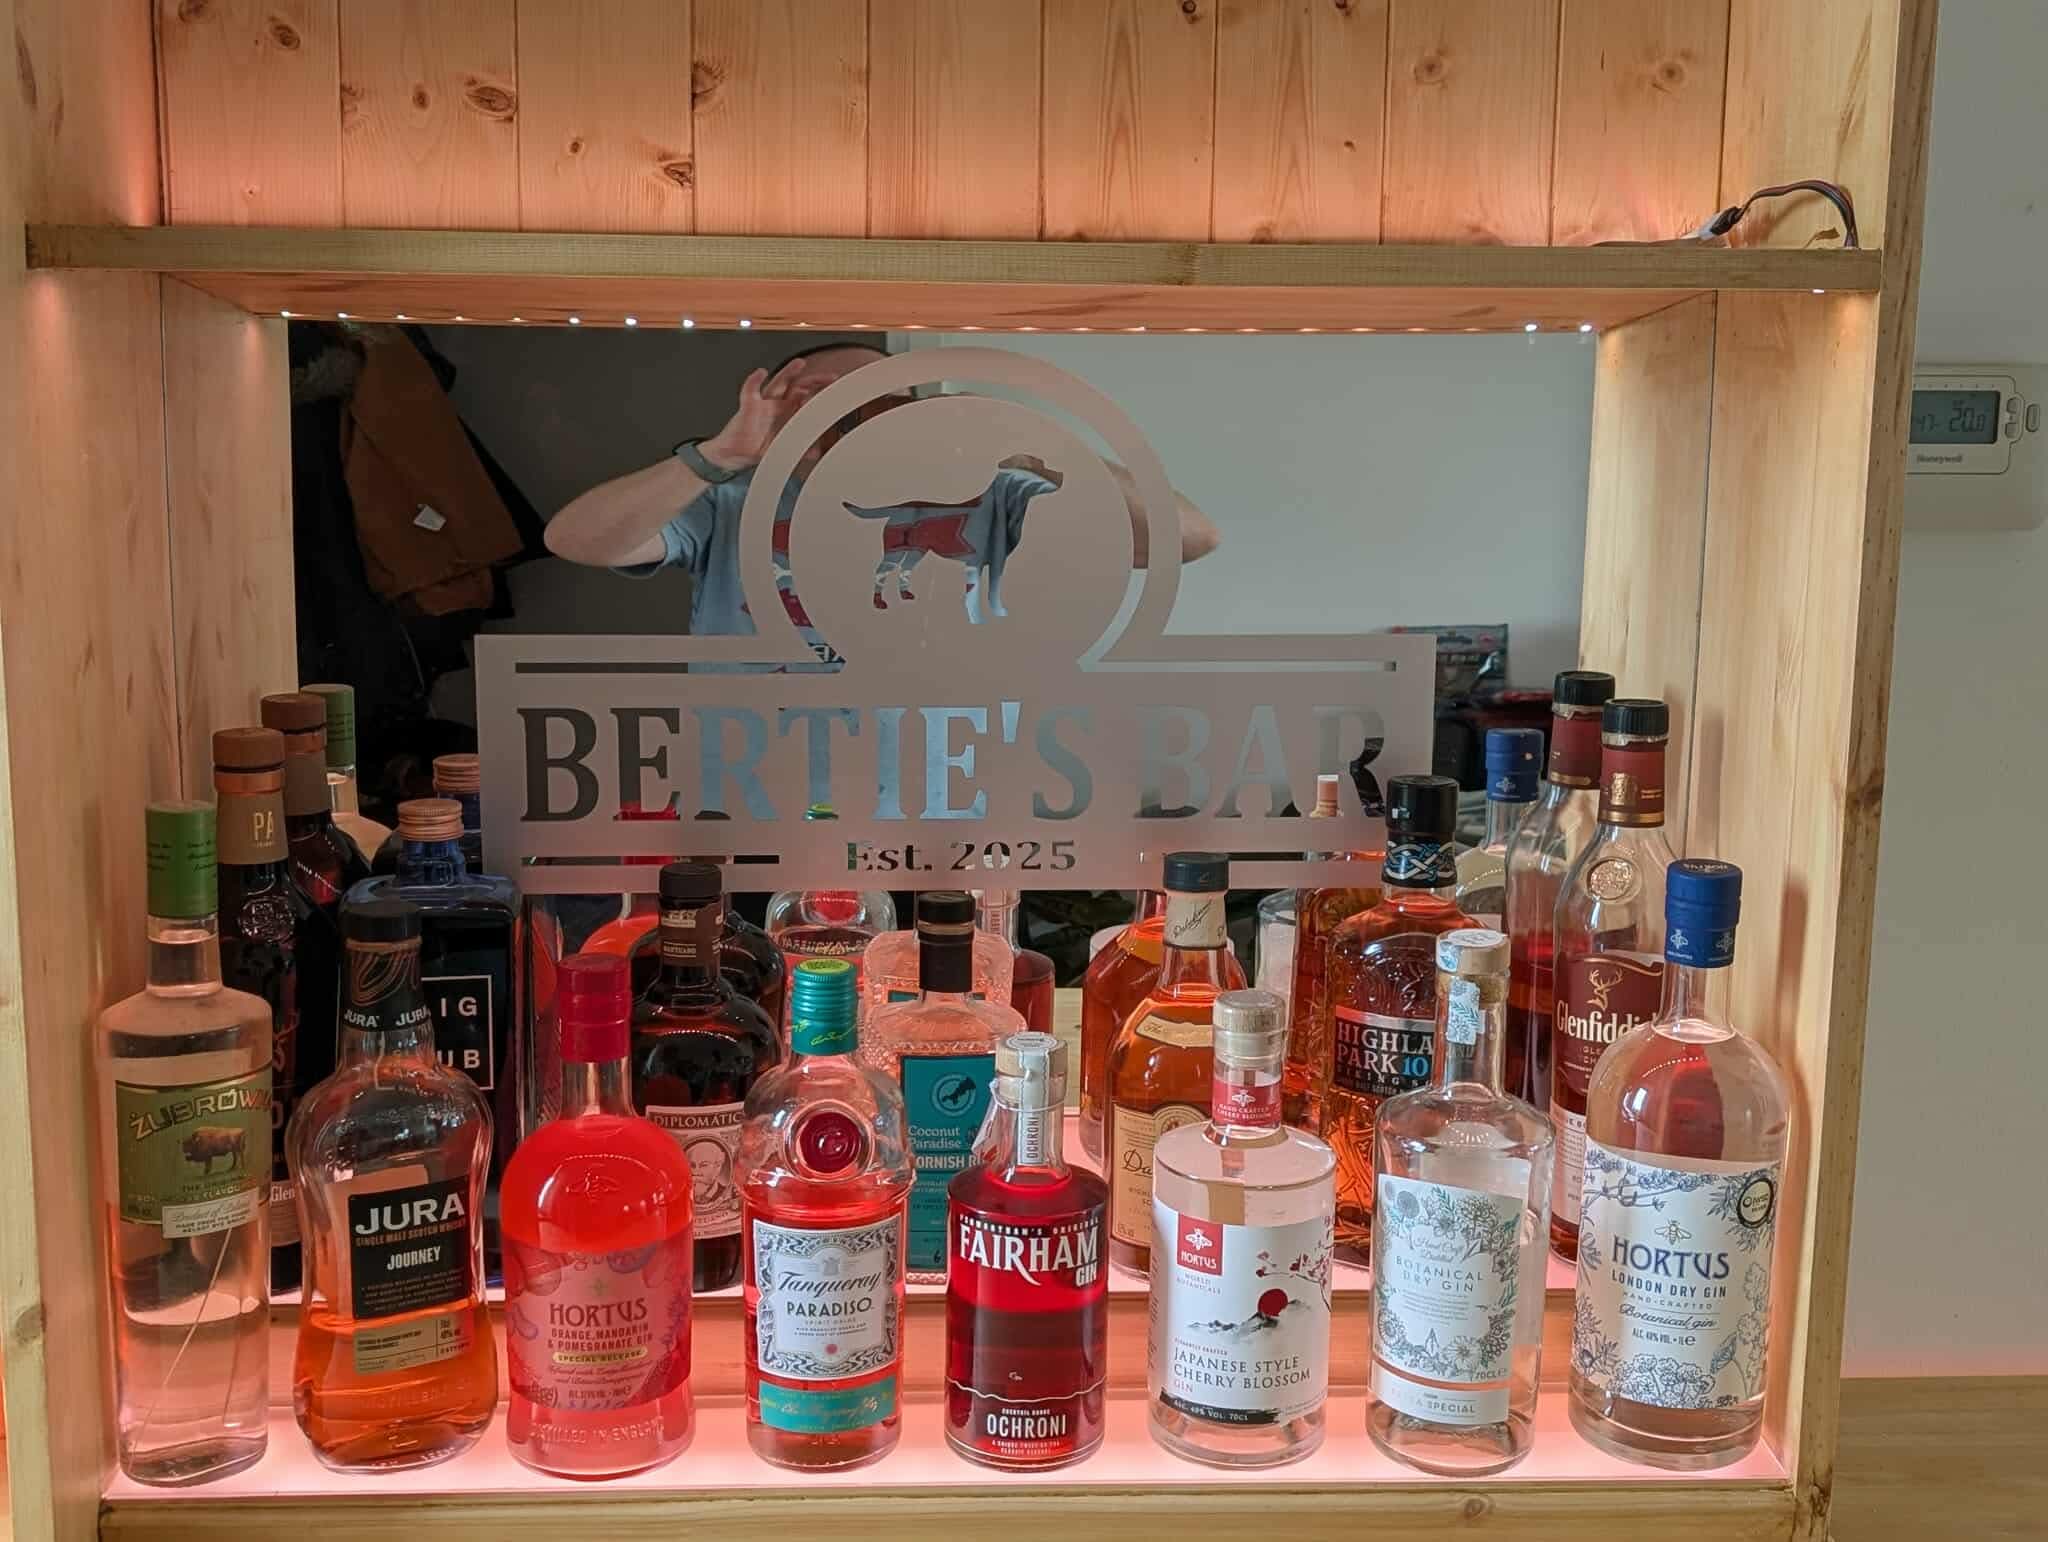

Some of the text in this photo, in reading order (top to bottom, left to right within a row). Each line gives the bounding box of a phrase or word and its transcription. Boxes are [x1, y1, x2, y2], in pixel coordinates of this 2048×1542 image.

[517, 702, 1386, 821] BERTIE'S BAR
[848, 840, 1076, 871] Est. 2025
[1557, 1000, 1657, 1043] Glenfidd
[1337, 1022, 1433, 1055] HIGHLA
[1338, 1043, 1429, 1077] PARK 10
[908, 1125, 961, 1137] Coconut
[908, 1137, 961, 1149] Paradise
[916, 1154, 965, 1169] ORNISH
[355, 1191, 465, 1235] JURA
[387, 1246, 442, 1271] JOURNEY
[960, 1223, 1099, 1286] FAIRHAM
[1181, 1250, 1217, 1269] HORTUS
[1396, 1255, 1484, 1281] BOTANICAL
[1611, 1234, 1730, 1280] HORTUS
[777, 1271, 882, 1298] Tanqueray
[1075, 1259, 1098, 1287] GIN
[1442, 1280, 1474, 1293] GIN
[1612, 1269, 1727, 1298] LONDON DRY GIN
[549, 1297, 648, 1328] HORTUS
[787, 1297, 873, 1318] PARADISO
[1619, 1303, 1693, 1328] Botanical
[558, 1336, 634, 1352] POMEGRANATE
[1174, 1346, 1300, 1373] JAPANESE STYLE
[1174, 1363, 1311, 1390] CHERRY BLOSSOM
[1174, 1379, 1194, 1393] GIN
[1427, 1401, 1476, 1414] SPECIAL
[987, 1413, 1067, 1439] OCHRONI
